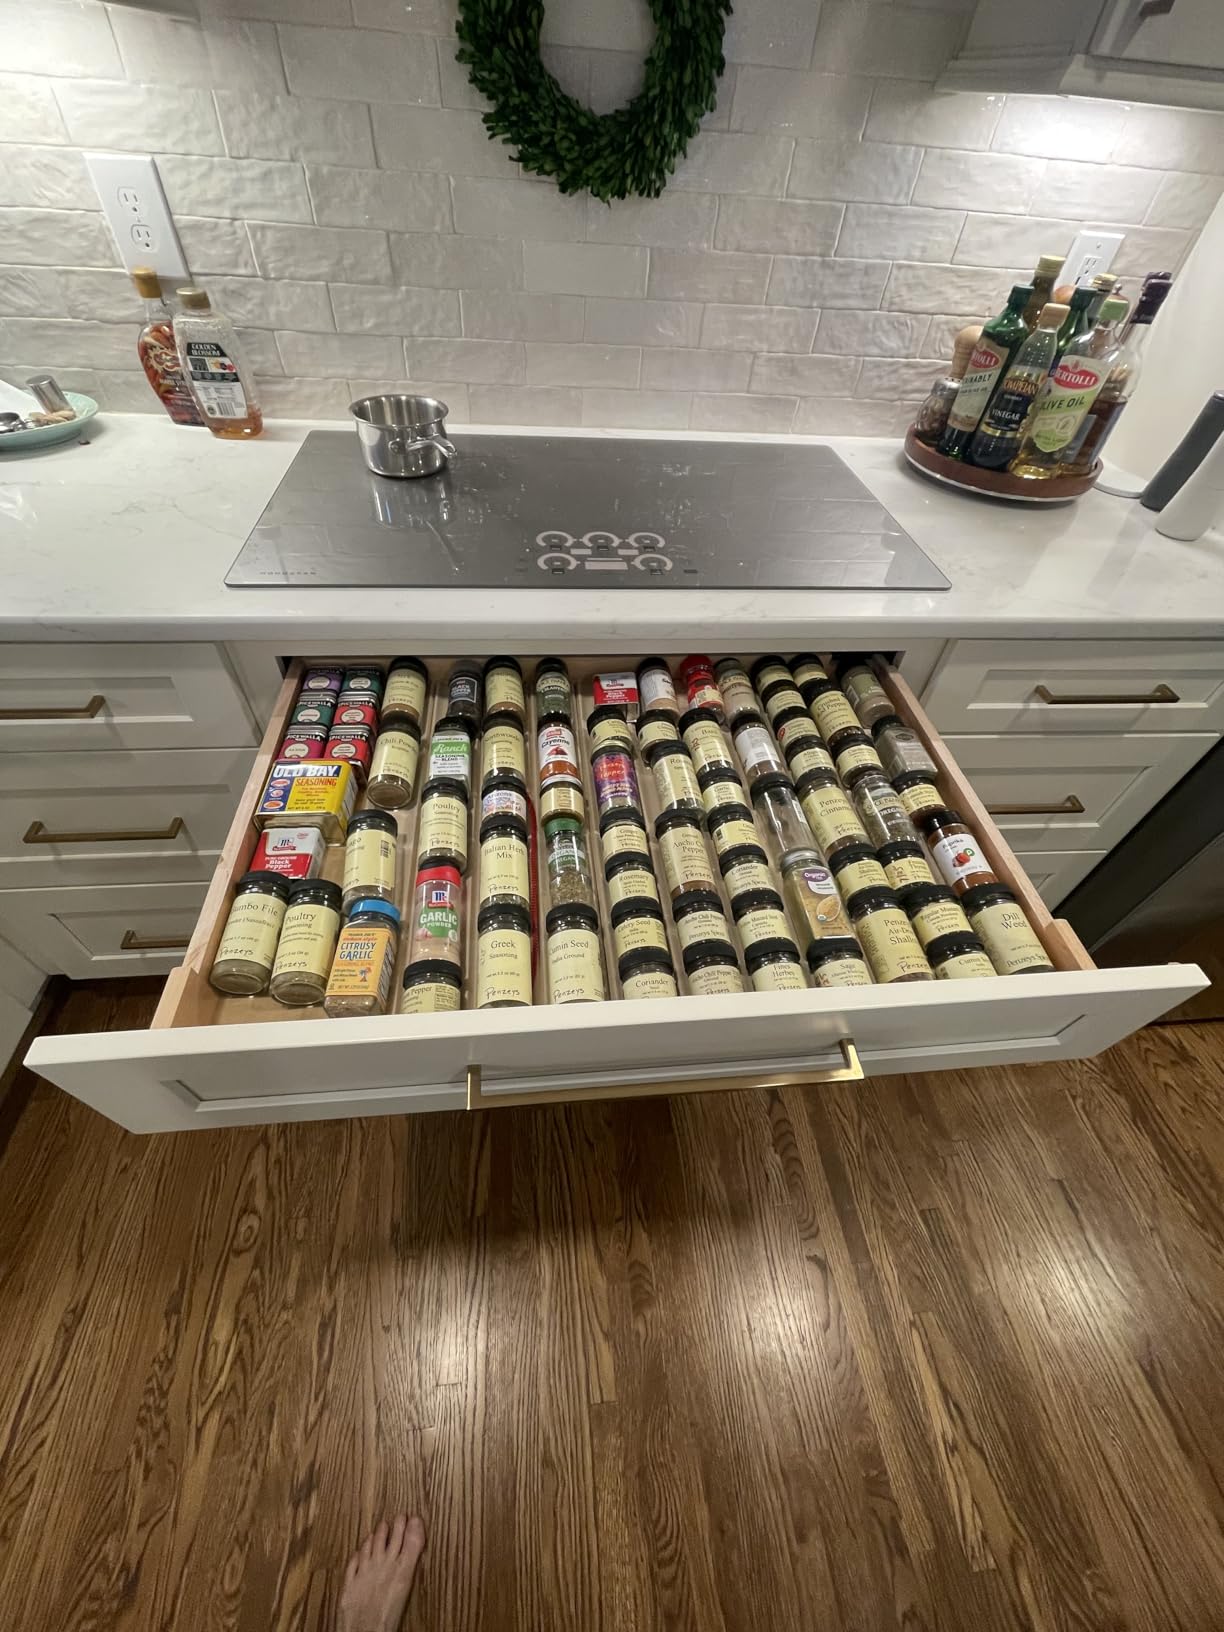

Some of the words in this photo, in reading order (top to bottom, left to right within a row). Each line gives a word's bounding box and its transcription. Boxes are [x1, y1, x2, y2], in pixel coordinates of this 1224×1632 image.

[1066, 396, 1085, 408] OIL
[991, 408, 1021, 421] VINEGAR
[433, 743, 467, 752] Ranch
[273, 765, 306, 778] OLD
[295, 778, 337, 787] SEASONING
[433, 803, 460, 812] Poultry
[820, 805, 852, 817] Cinnam
[487, 884, 519, 893] Penzeys
[261, 903, 278, 917] File
[420, 911, 457, 925] GARLIC
[1002, 912, 1020, 921] Dill
[883, 919, 908, 927] Penze
[1001, 920, 1028, 929] Weed
[340, 941, 377, 950] CITRUSY
[490, 940, 516, 949] Greek
[570, 939, 589, 949] Seed
[220, 946, 254, 956] Penzeys
[339, 950, 373, 961] GARLIC
[635, 979, 669, 988] Coriander
[411, 986, 433, 994] Pepper
[485, 987, 520, 999] Penzeys
[553, 988, 585, 1003] Penzeys
